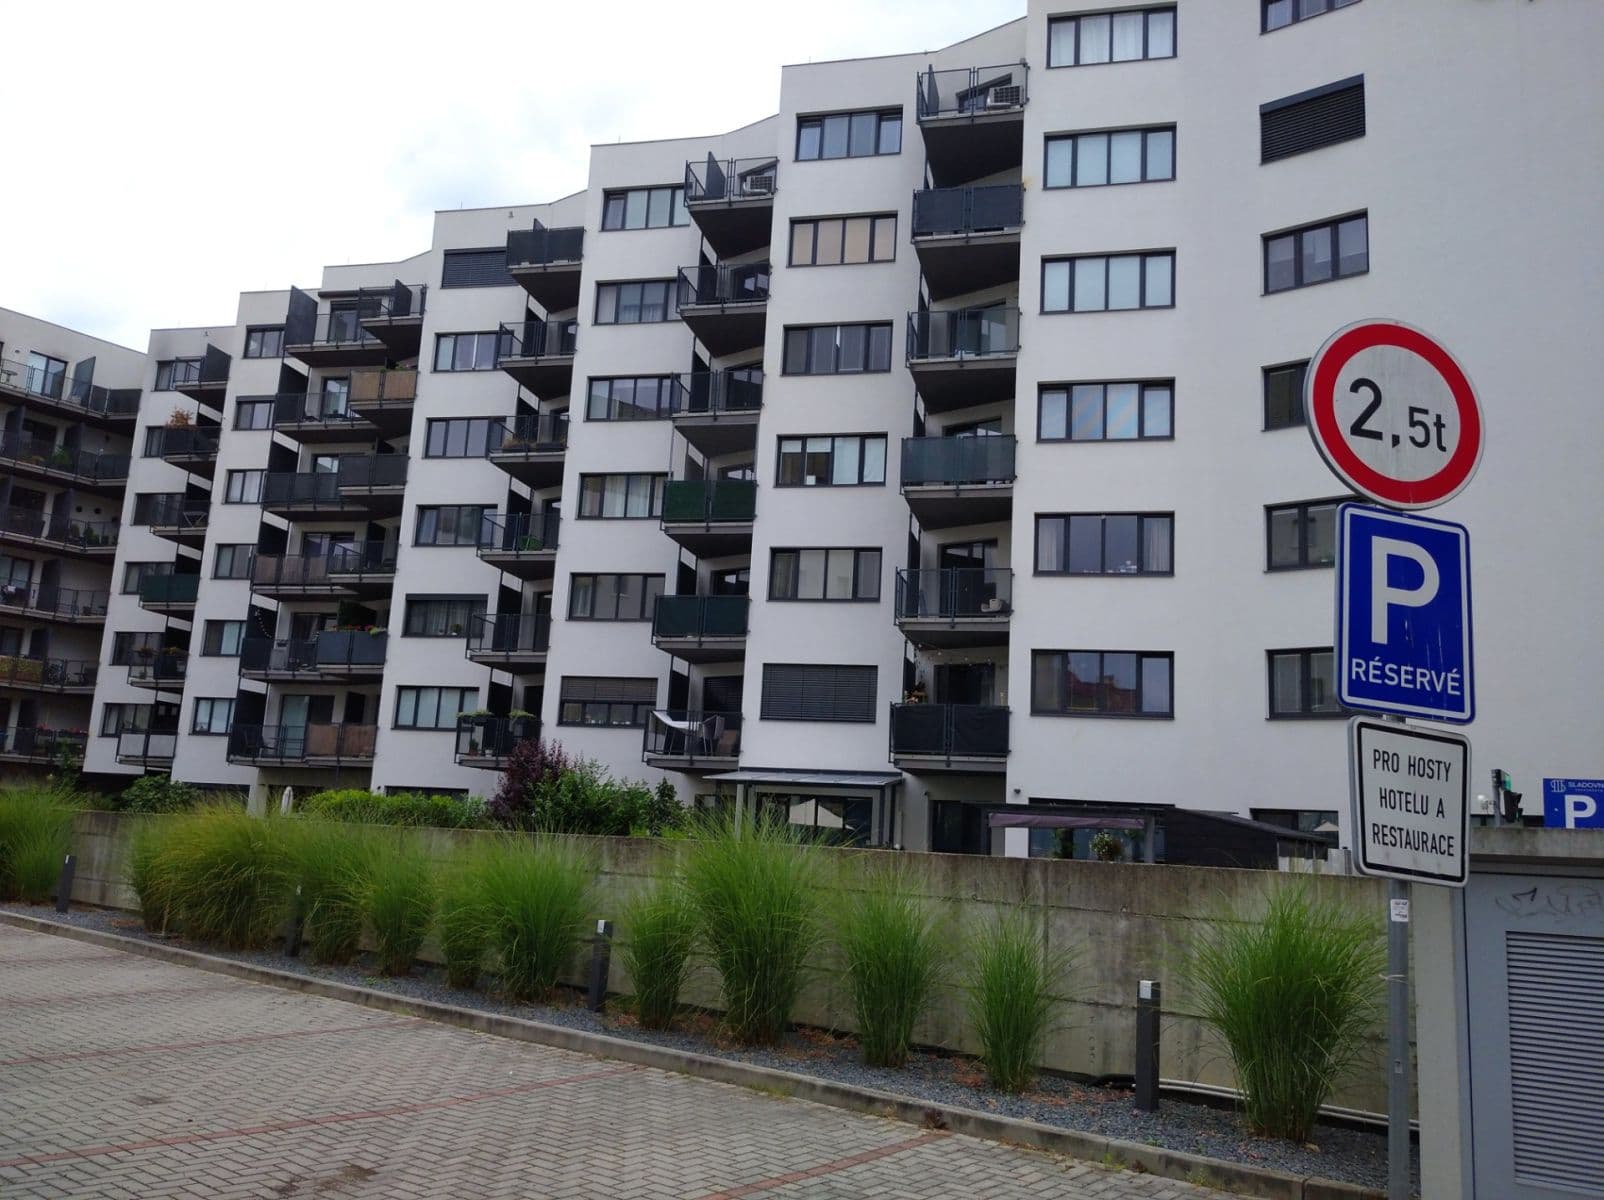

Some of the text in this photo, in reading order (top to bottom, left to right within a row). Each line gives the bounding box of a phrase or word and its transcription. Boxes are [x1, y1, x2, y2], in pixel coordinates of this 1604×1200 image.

[1349, 378, 1447, 452] 2,5t
[1371, 535, 1440, 645] P
[1351, 656, 1461, 696] RÉSERVÉ
[1373, 749, 1452, 782] PRO HOSTY
[1379, 787, 1445, 819] HOTELU A
[1564, 794, 1597, 829] P
[1372, 823, 1455, 857] RESTAURACE
